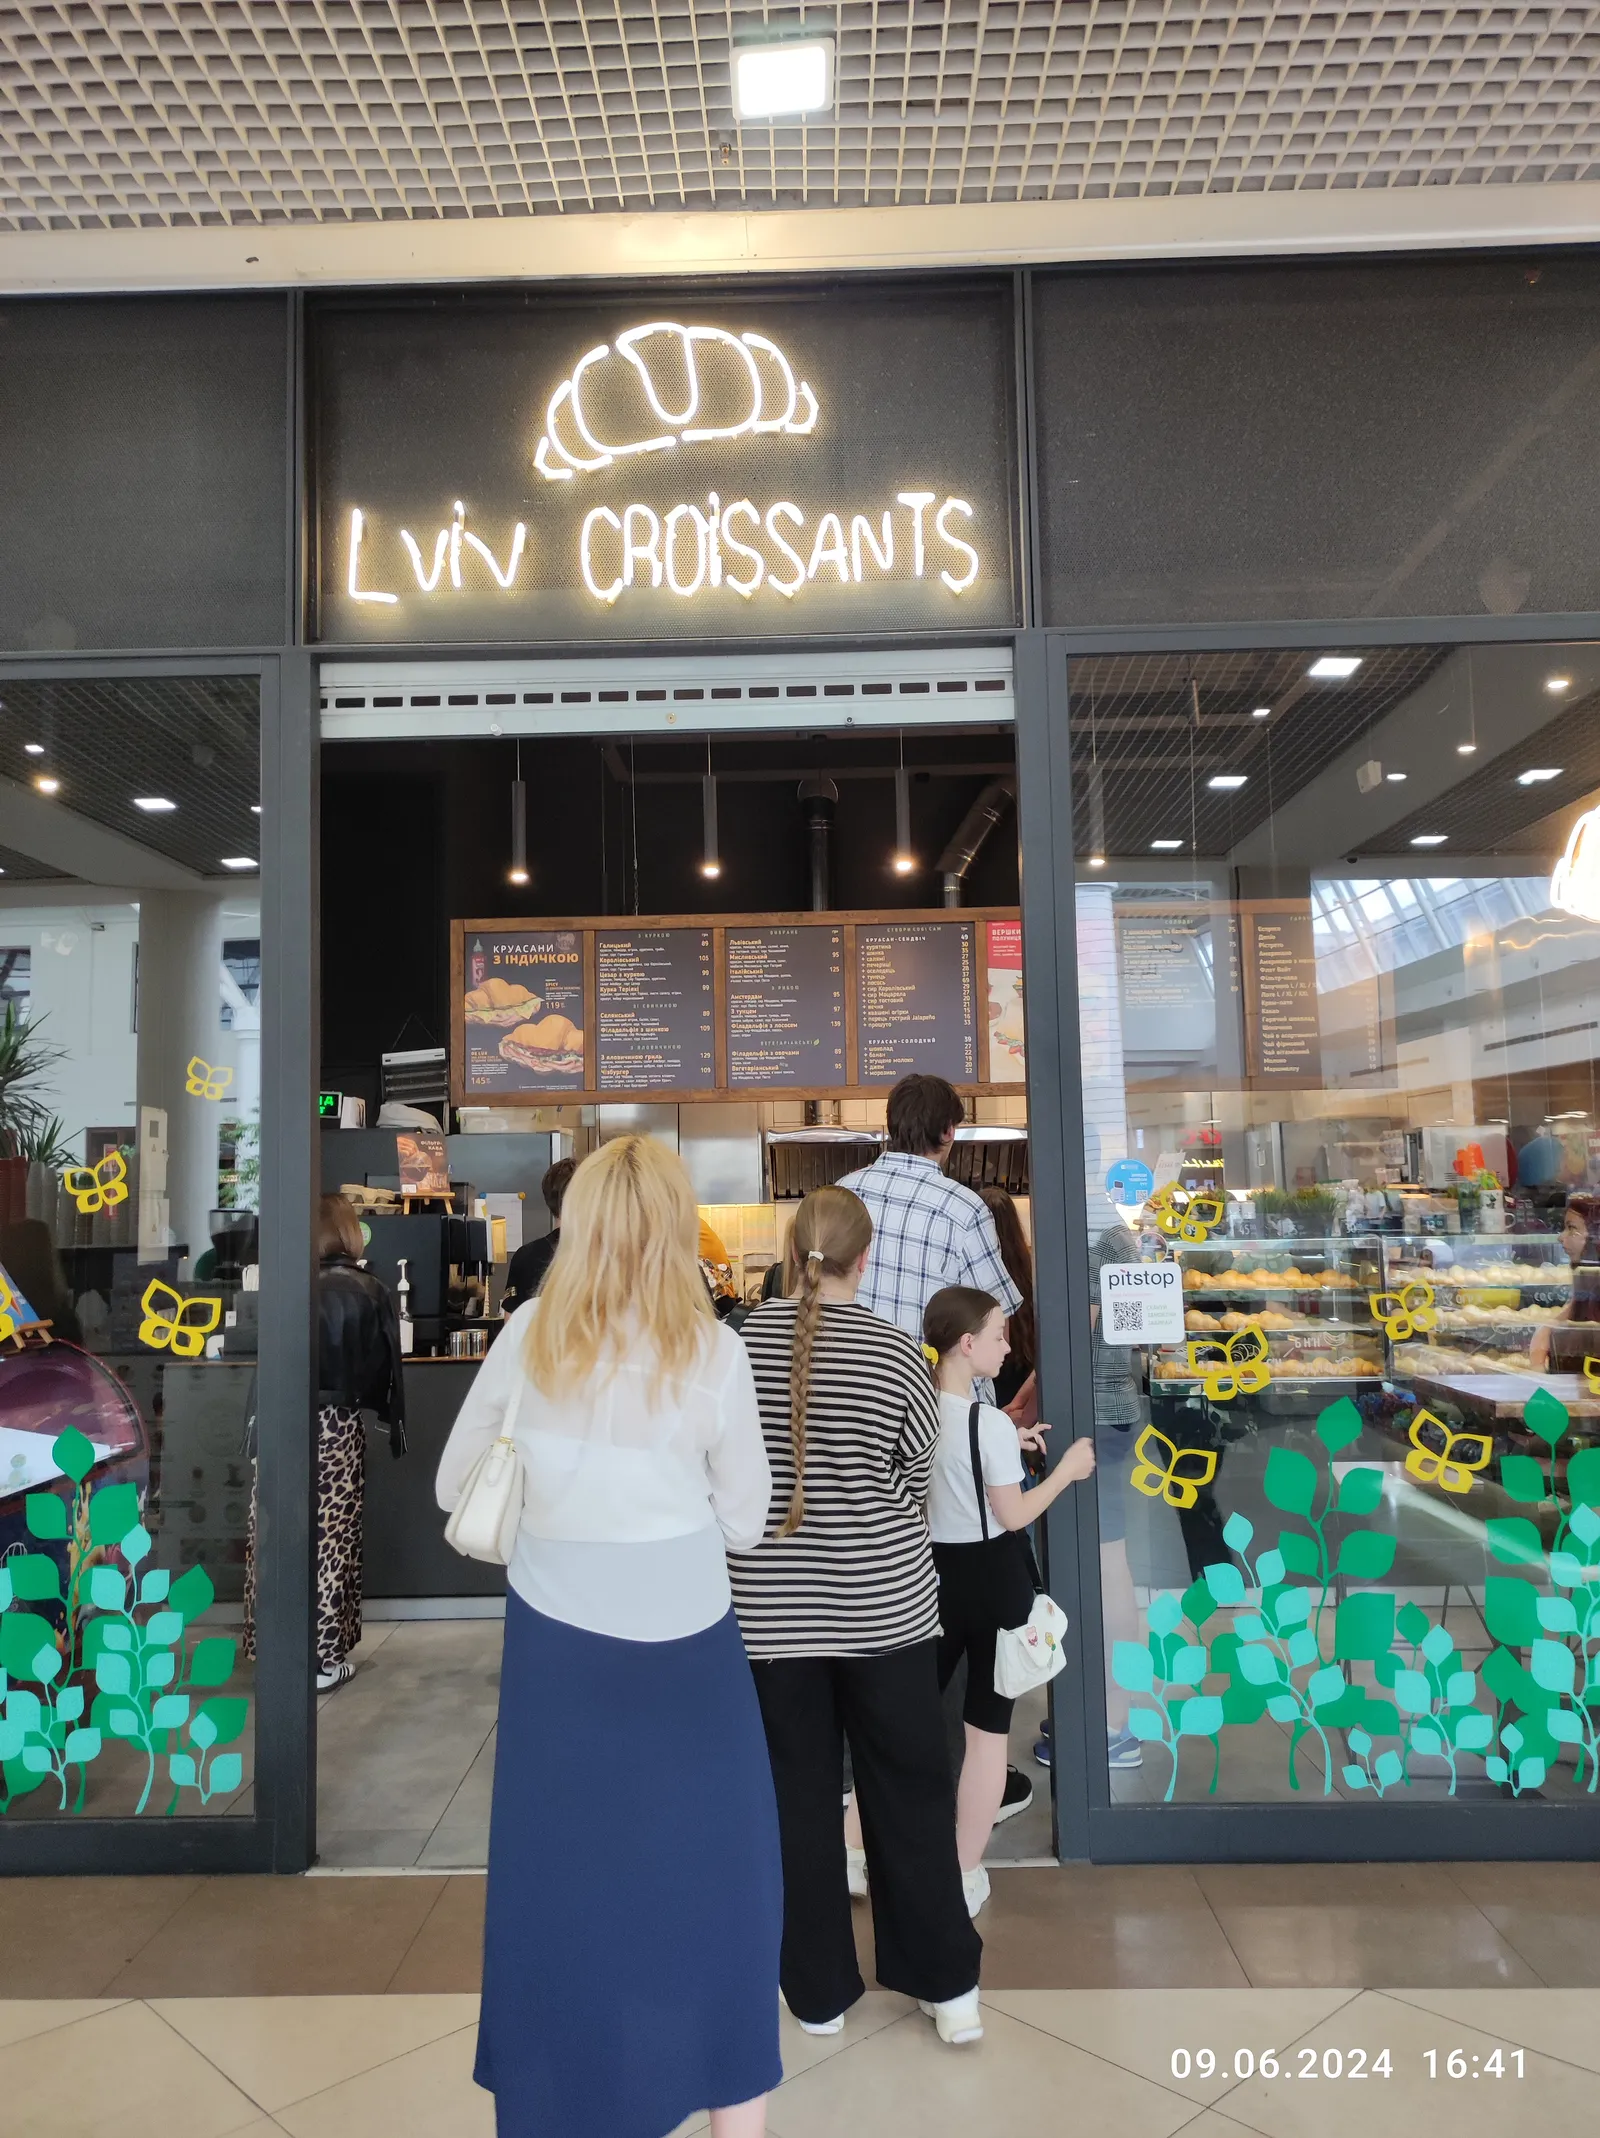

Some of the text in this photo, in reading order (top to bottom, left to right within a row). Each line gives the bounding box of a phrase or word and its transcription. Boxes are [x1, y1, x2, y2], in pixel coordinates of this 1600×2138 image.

[493, 944, 554, 953] КРУАСАНИ
[493, 953, 579, 966] З ІНДИЧКОЮ
[471, 1077, 486, 1085] 145
[1108, 1269, 1174, 1290] pitstop
